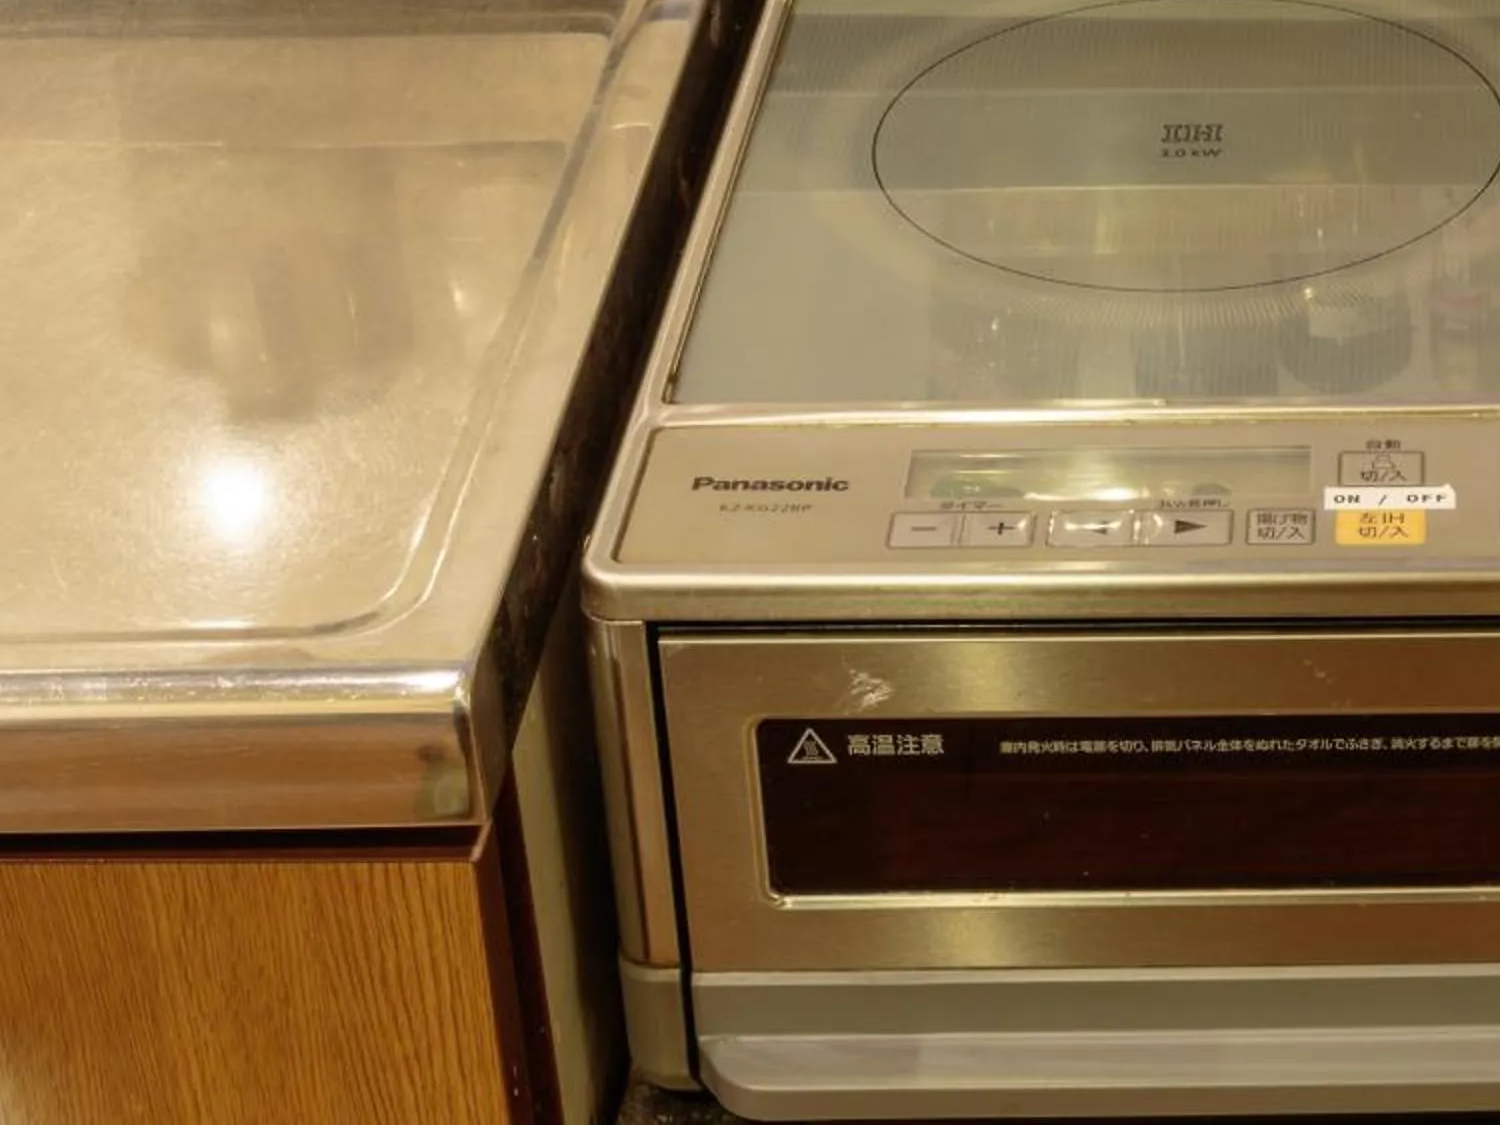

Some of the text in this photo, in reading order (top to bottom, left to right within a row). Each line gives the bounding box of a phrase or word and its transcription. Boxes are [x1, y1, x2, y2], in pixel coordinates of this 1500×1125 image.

[691, 476, 849, 492] Panasonic
[1333, 493, 1361, 505] ON
[1406, 493, 1449, 505] OFF
[847, 733, 945, 756] 高温注意
